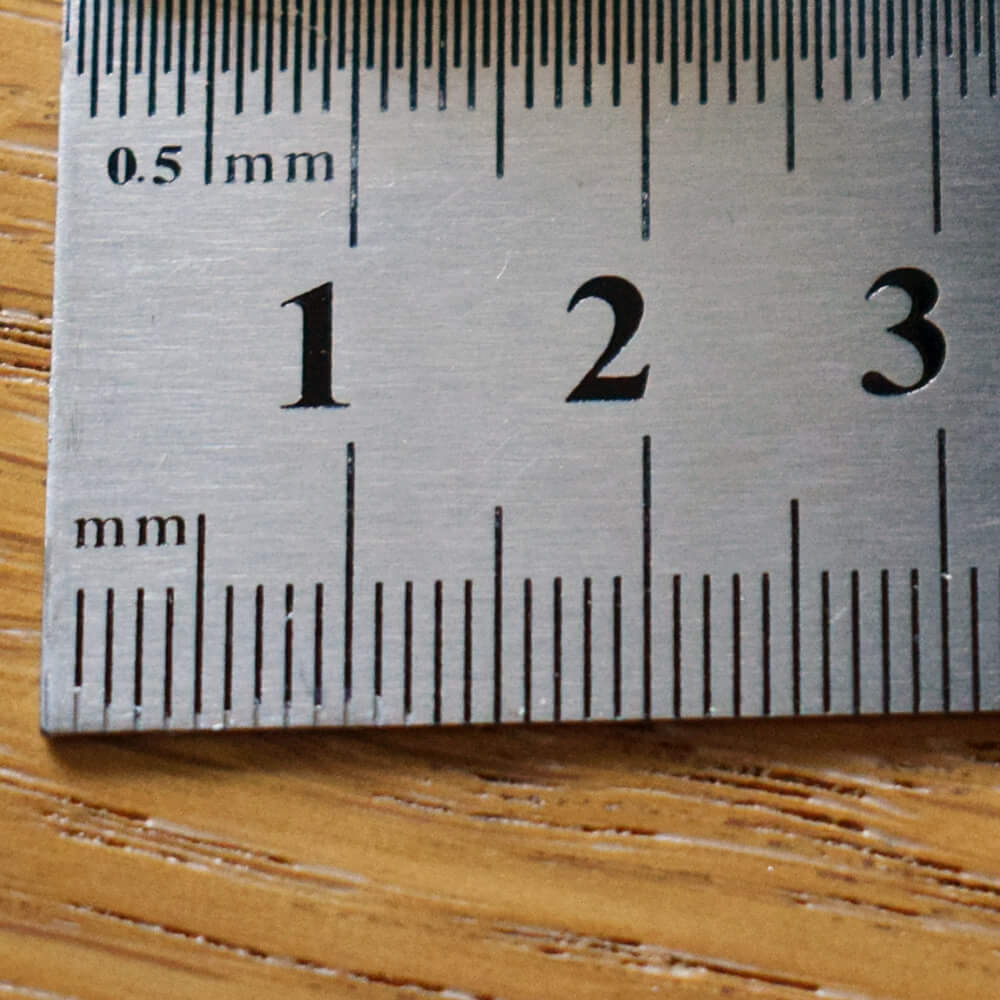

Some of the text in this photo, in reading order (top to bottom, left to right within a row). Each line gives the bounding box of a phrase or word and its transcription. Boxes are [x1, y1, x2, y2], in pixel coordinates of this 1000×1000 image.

[107, 145, 335, 186] 0.5 mm
[280, 281, 350, 409] 1
[565, 275, 651, 403] 2
[860, 266, 947, 397] 3
[74, 514, 187, 549] mm
